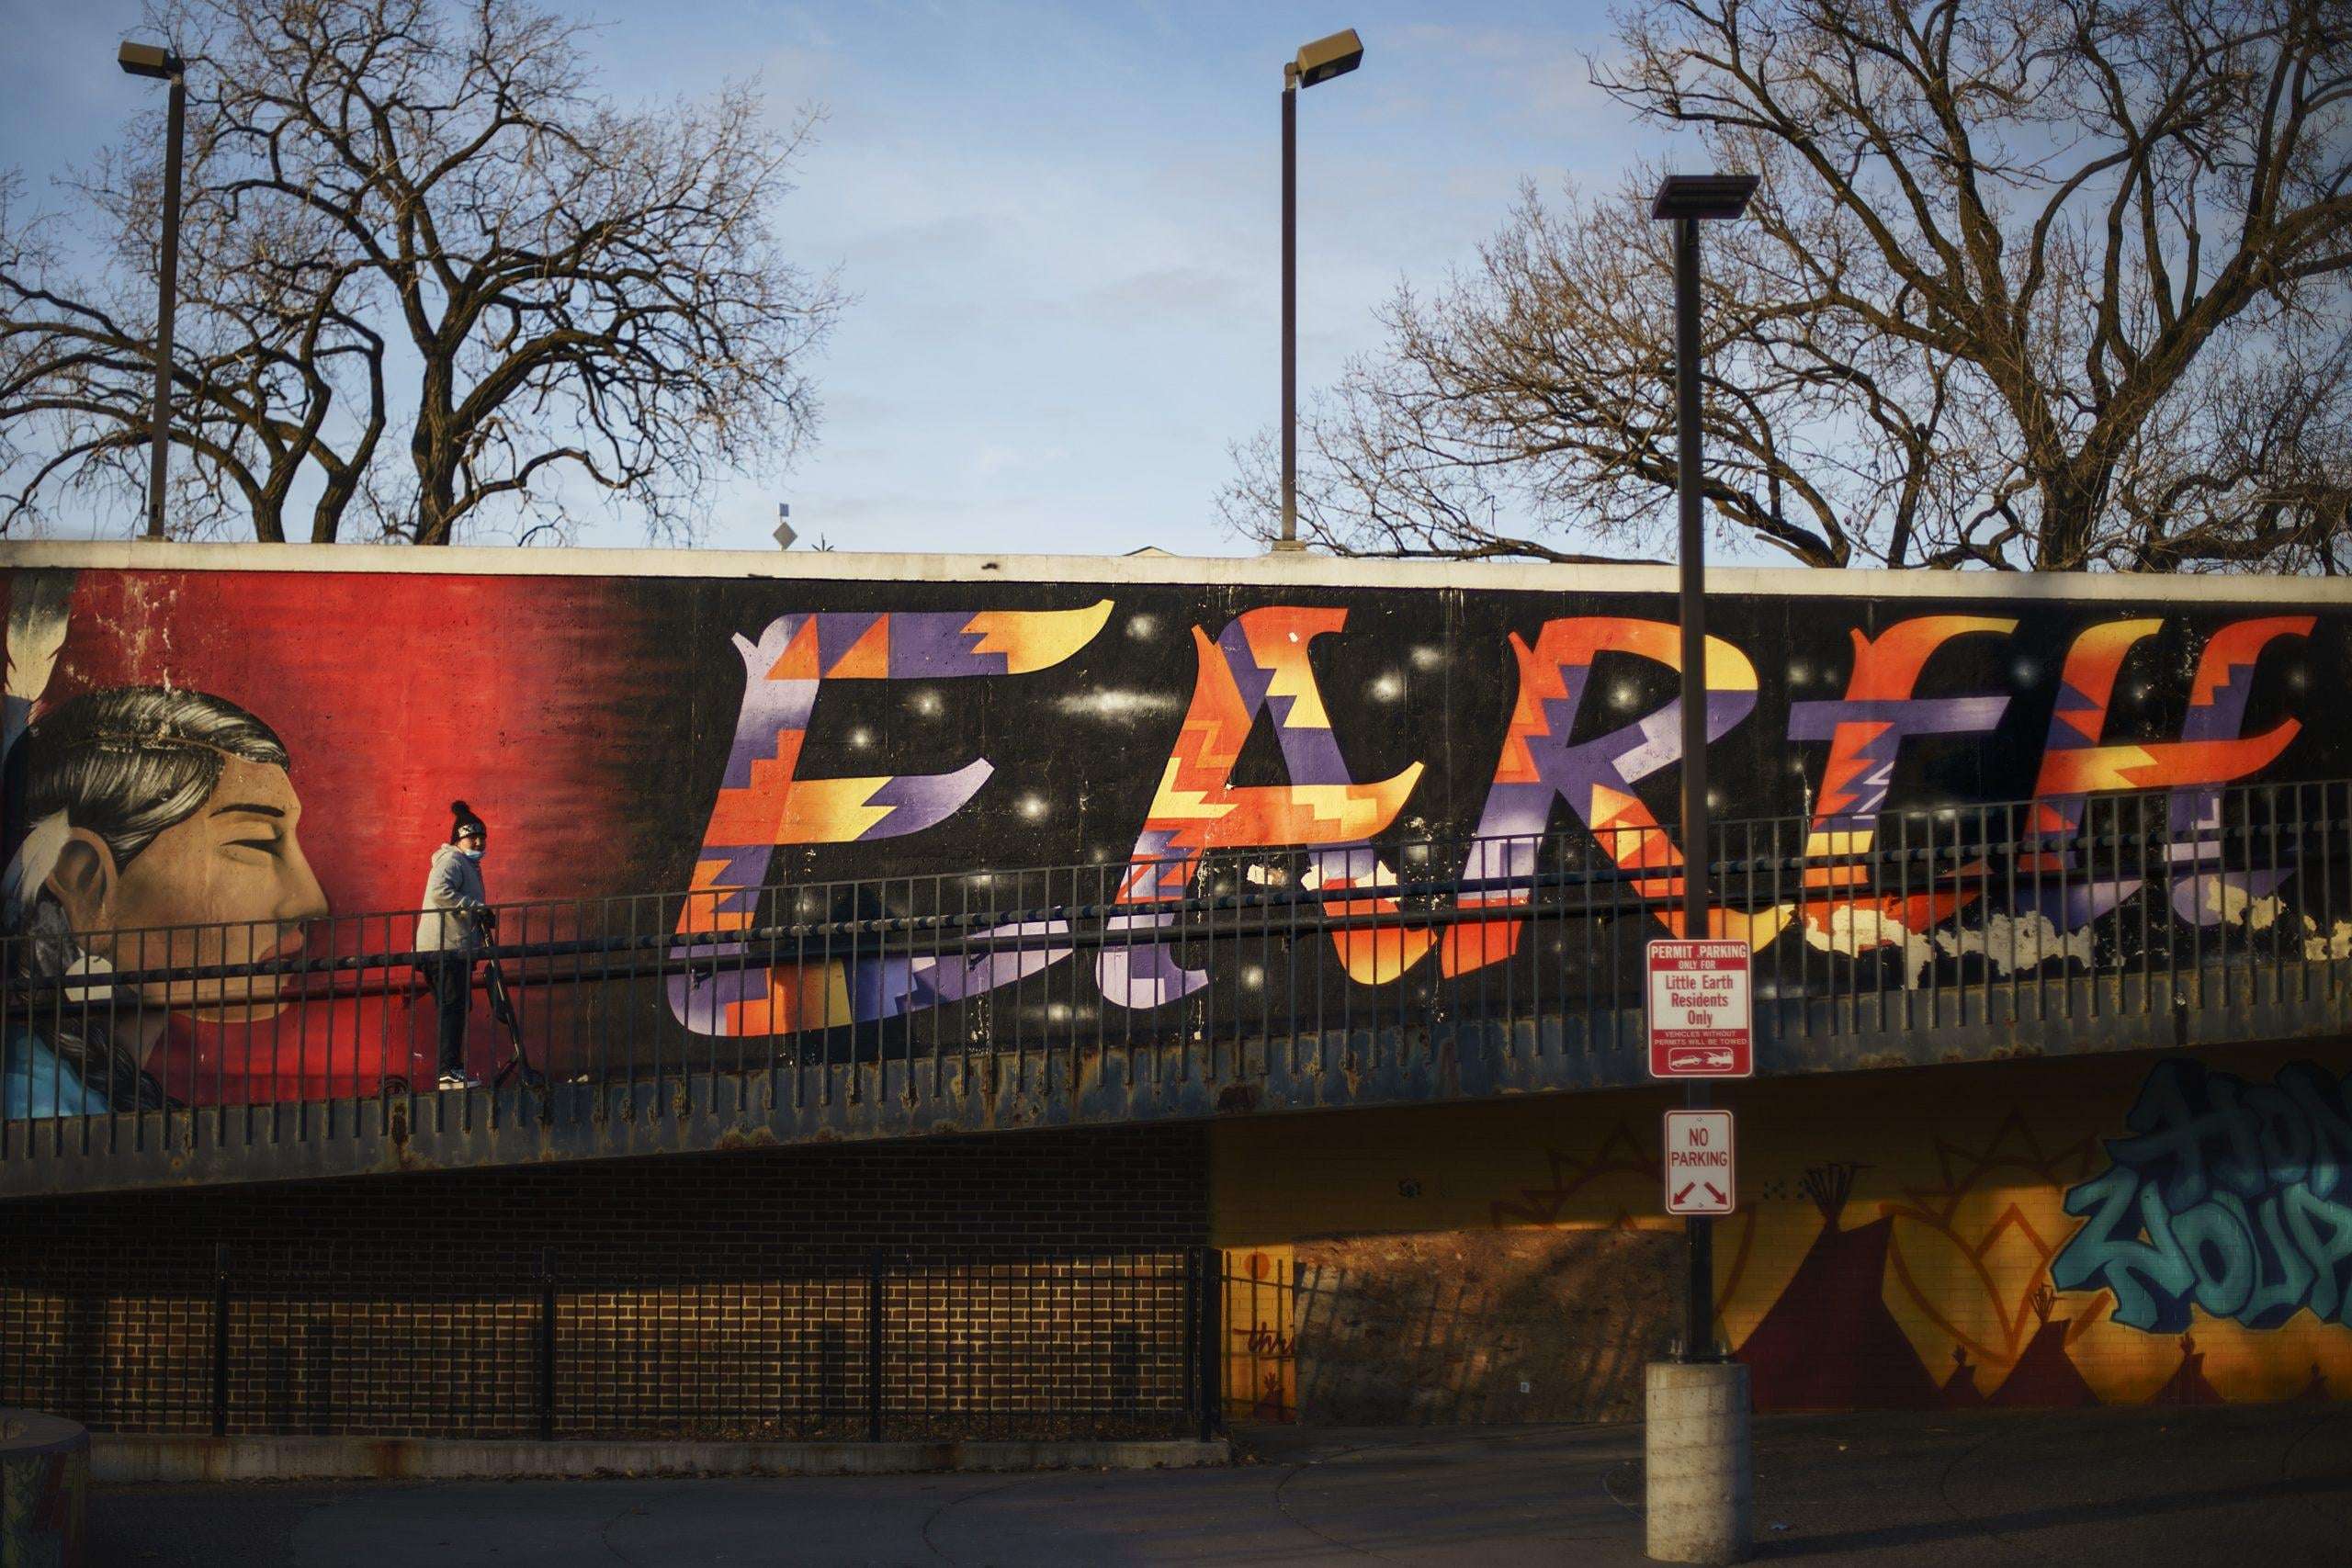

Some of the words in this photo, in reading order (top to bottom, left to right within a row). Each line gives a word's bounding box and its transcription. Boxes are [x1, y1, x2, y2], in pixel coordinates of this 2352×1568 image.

[666, 599, 2317, 1036] EARTH
[1652, 946, 1692, 959] PERMIT
[1700, 945, 1747, 958] PARKING
[1679, 960, 1697, 969] ONLY
[1701, 960, 1716, 969] FOR
[1666, 975, 1696, 989] Little
[1702, 975, 1734, 989] Earth
[1671, 993, 1728, 1007] Residents
[1688, 1010, 1713, 1027] Only
[1690, 1128, 1708, 1146] NO
[1671, 1152, 1727, 1167] PARKING
